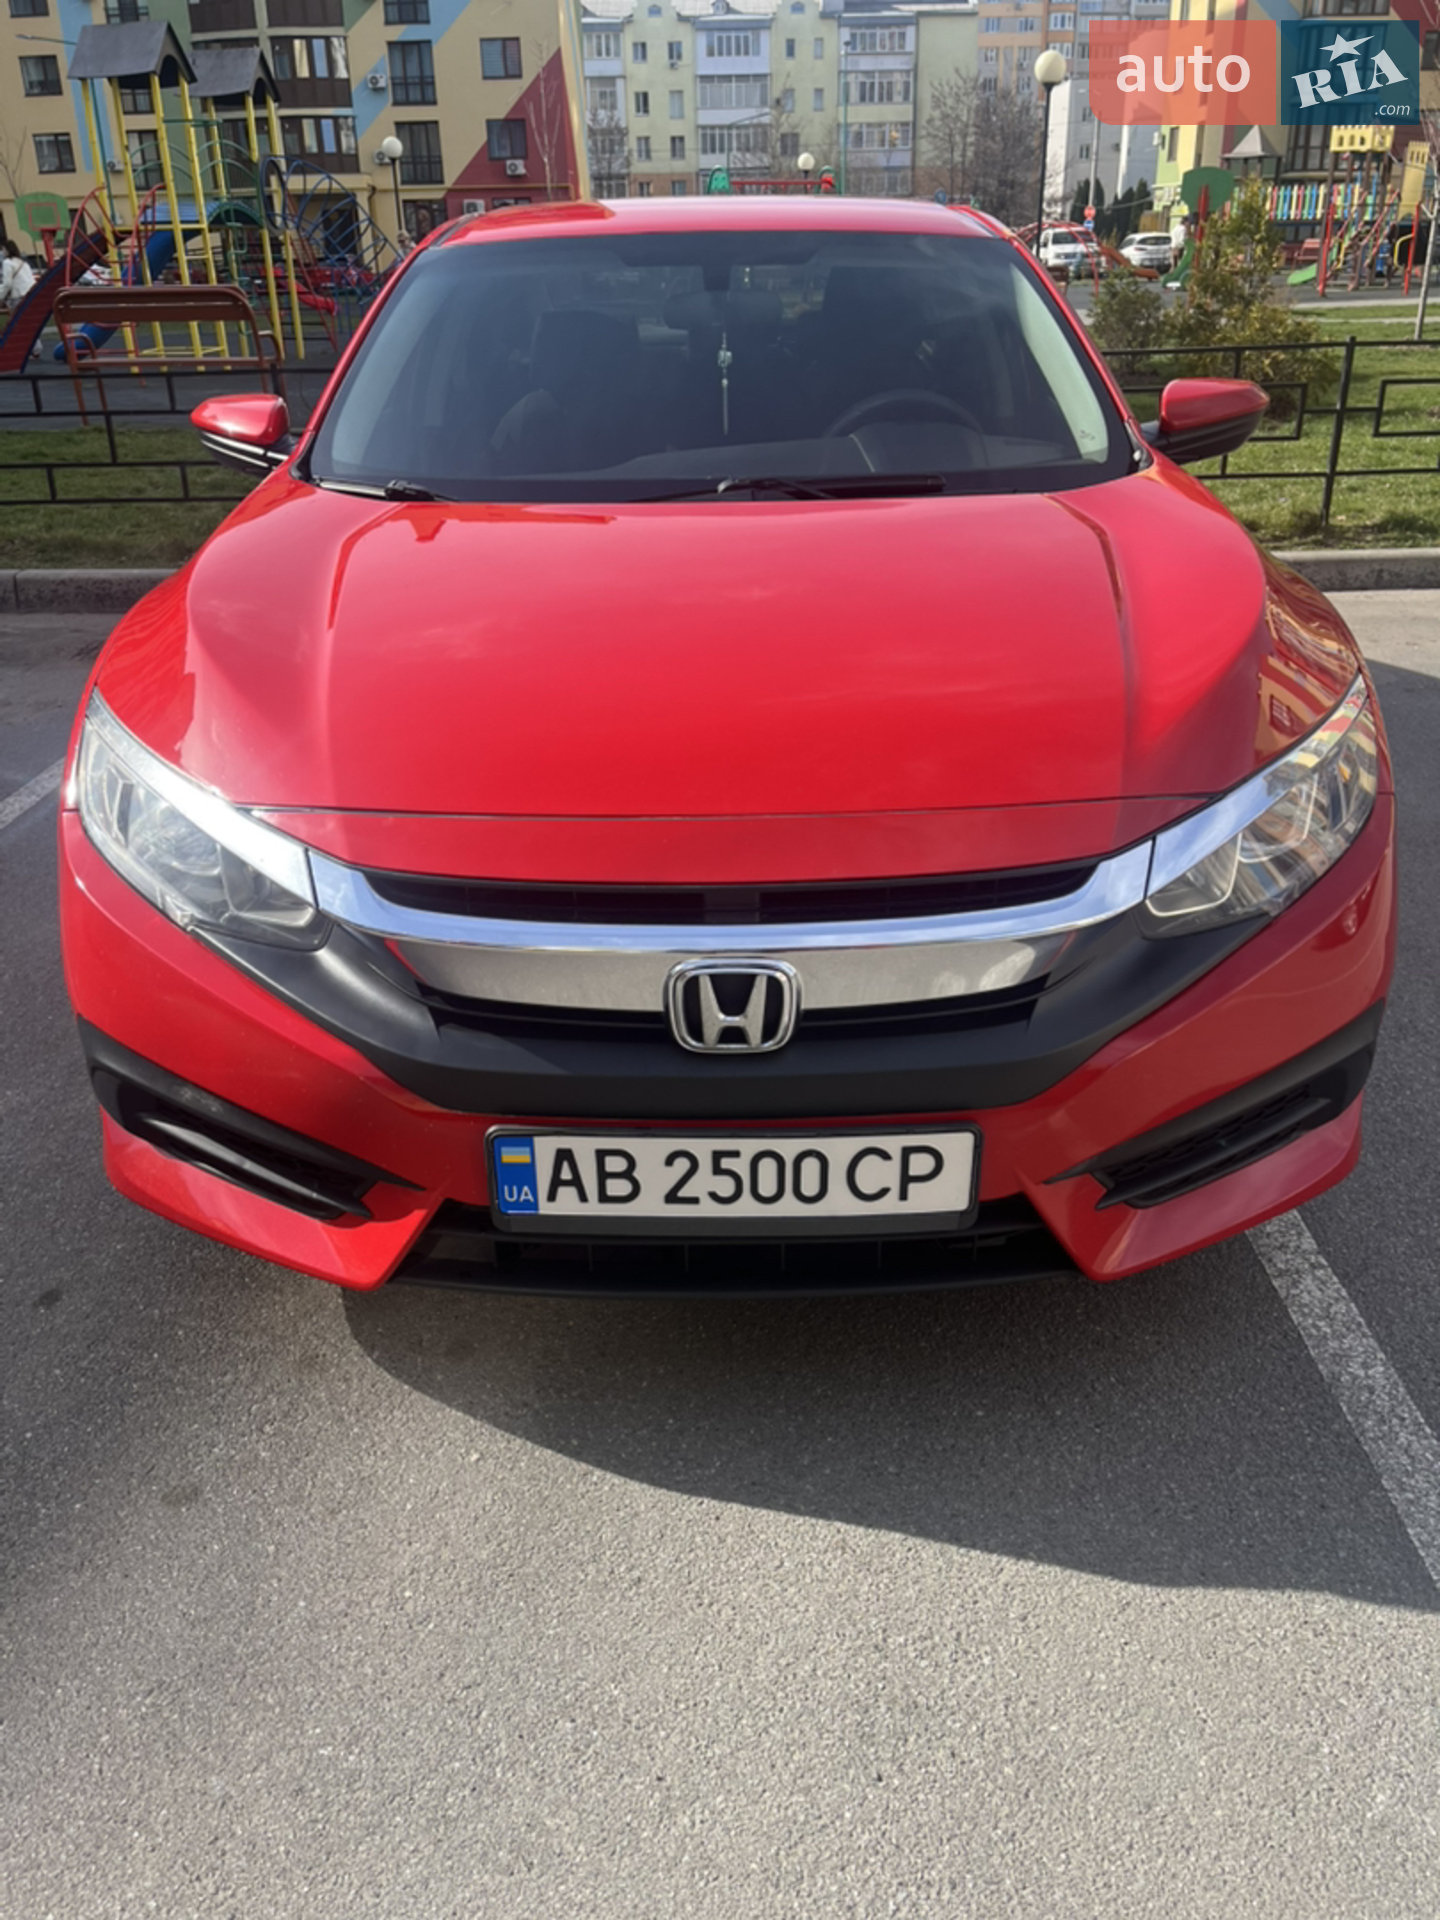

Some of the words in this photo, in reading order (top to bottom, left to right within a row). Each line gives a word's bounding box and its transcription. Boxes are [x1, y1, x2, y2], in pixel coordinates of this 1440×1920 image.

[503, 1185, 535, 1203] UA
[546, 1147, 642, 1204] AB
[663, 1148, 830, 1206] 2500
[845, 1145, 945, 1204] CP
